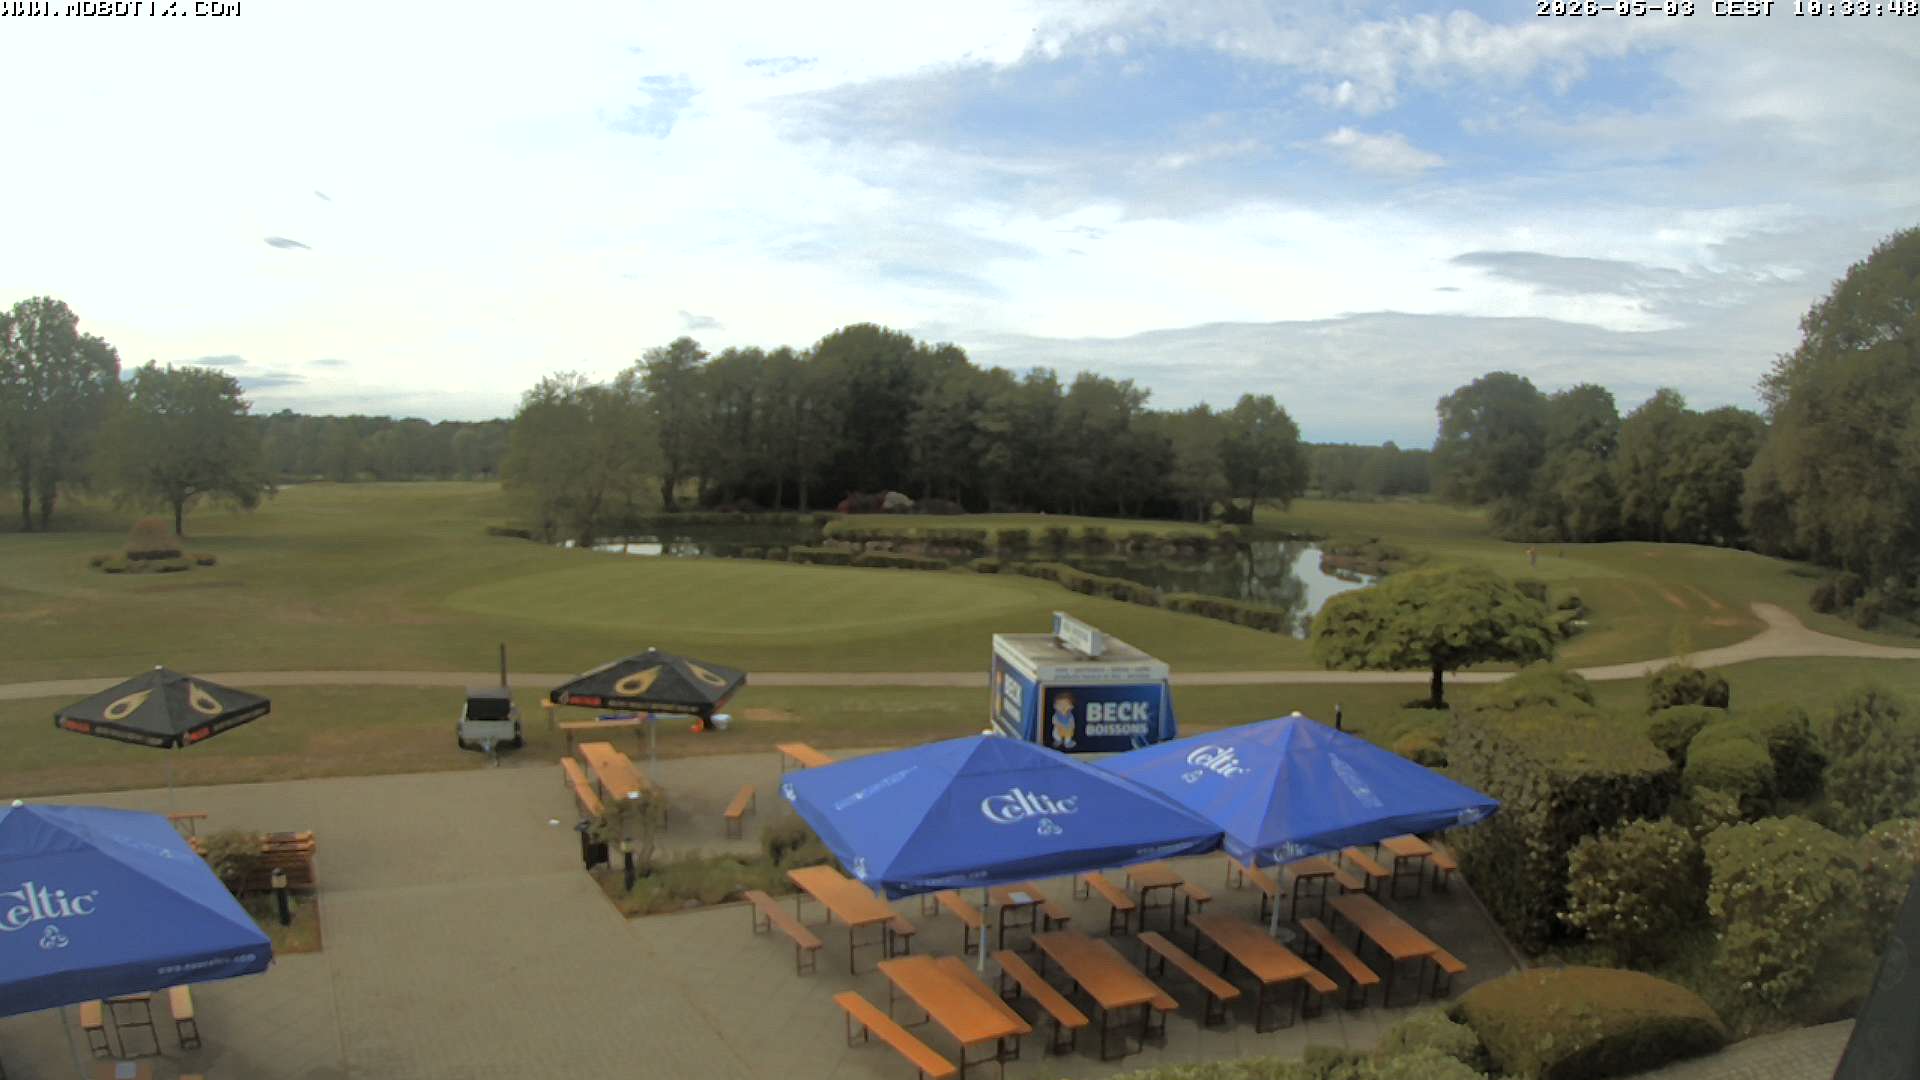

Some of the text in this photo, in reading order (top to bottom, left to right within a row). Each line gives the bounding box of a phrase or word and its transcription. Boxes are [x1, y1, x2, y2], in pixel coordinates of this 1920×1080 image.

[1087, 702, 1149, 721] BECK
[1085, 723, 1149, 736] BOISSONS
[1187, 744, 1244, 778] Celtic
[981, 786, 1079, 824] Celtic
